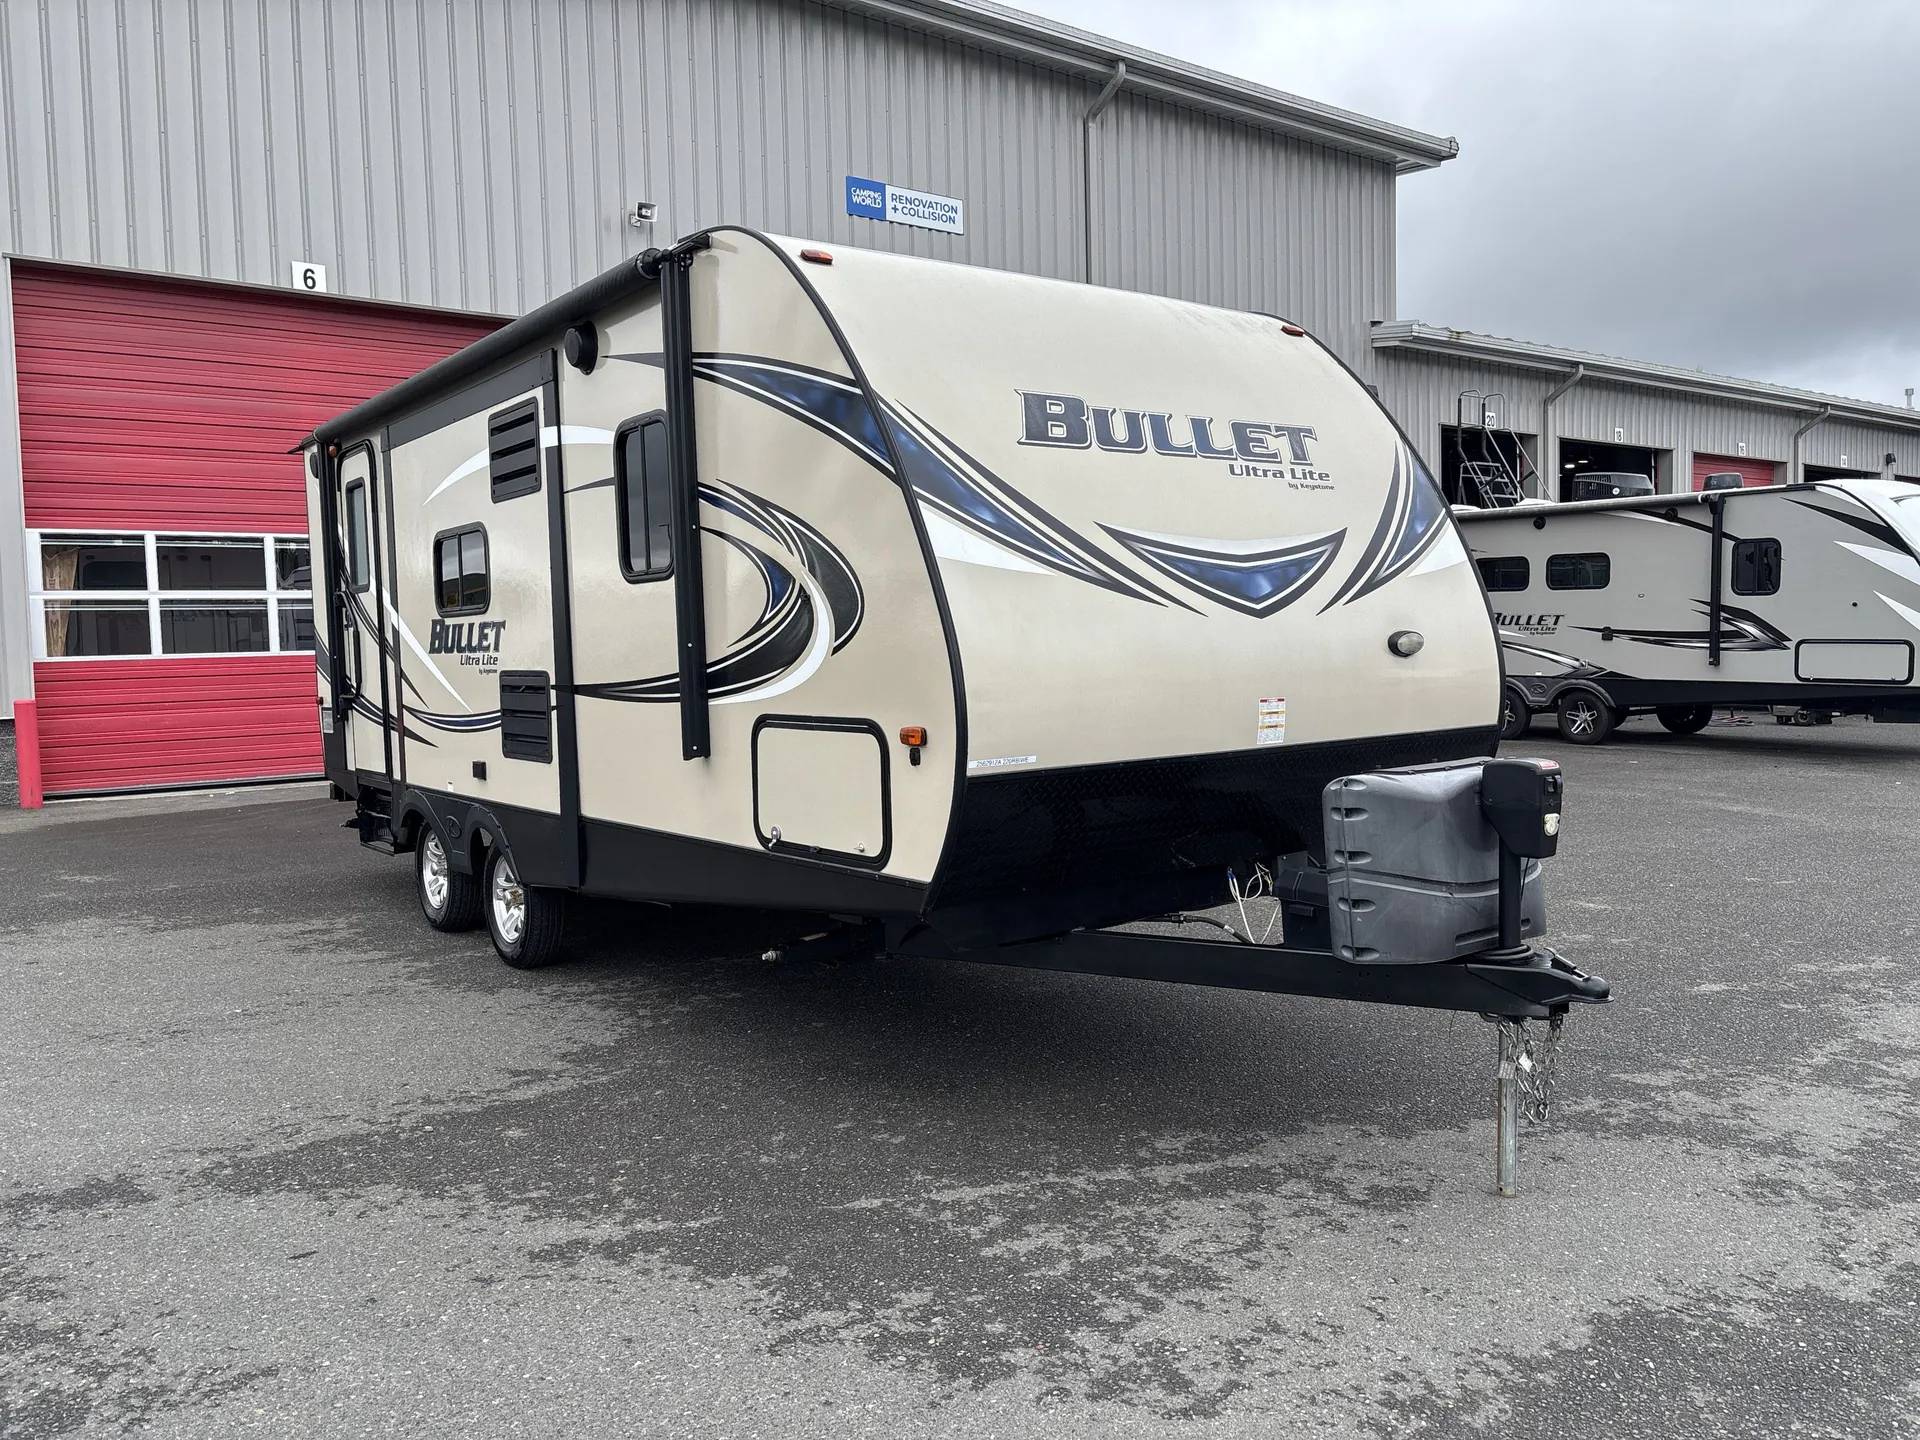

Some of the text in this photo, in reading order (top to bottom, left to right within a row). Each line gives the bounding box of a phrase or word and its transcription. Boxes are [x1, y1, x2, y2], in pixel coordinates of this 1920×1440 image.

[851, 187, 882, 200] CAMPING
[851, 194, 882, 208] WORLD
[891, 193, 958, 215] RENOVATION
[901, 206, 956, 225] COLLISION
[303, 268, 316, 290] 6
[1013, 388, 1318, 467] BULLET
[1486, 415, 1495, 427] 20
[1228, 463, 1331, 482] Ultra Lite
[1288, 482, 1299, 490] by
[429, 619, 506, 654] BULLET
[460, 654, 499, 666] Ultra Lite
